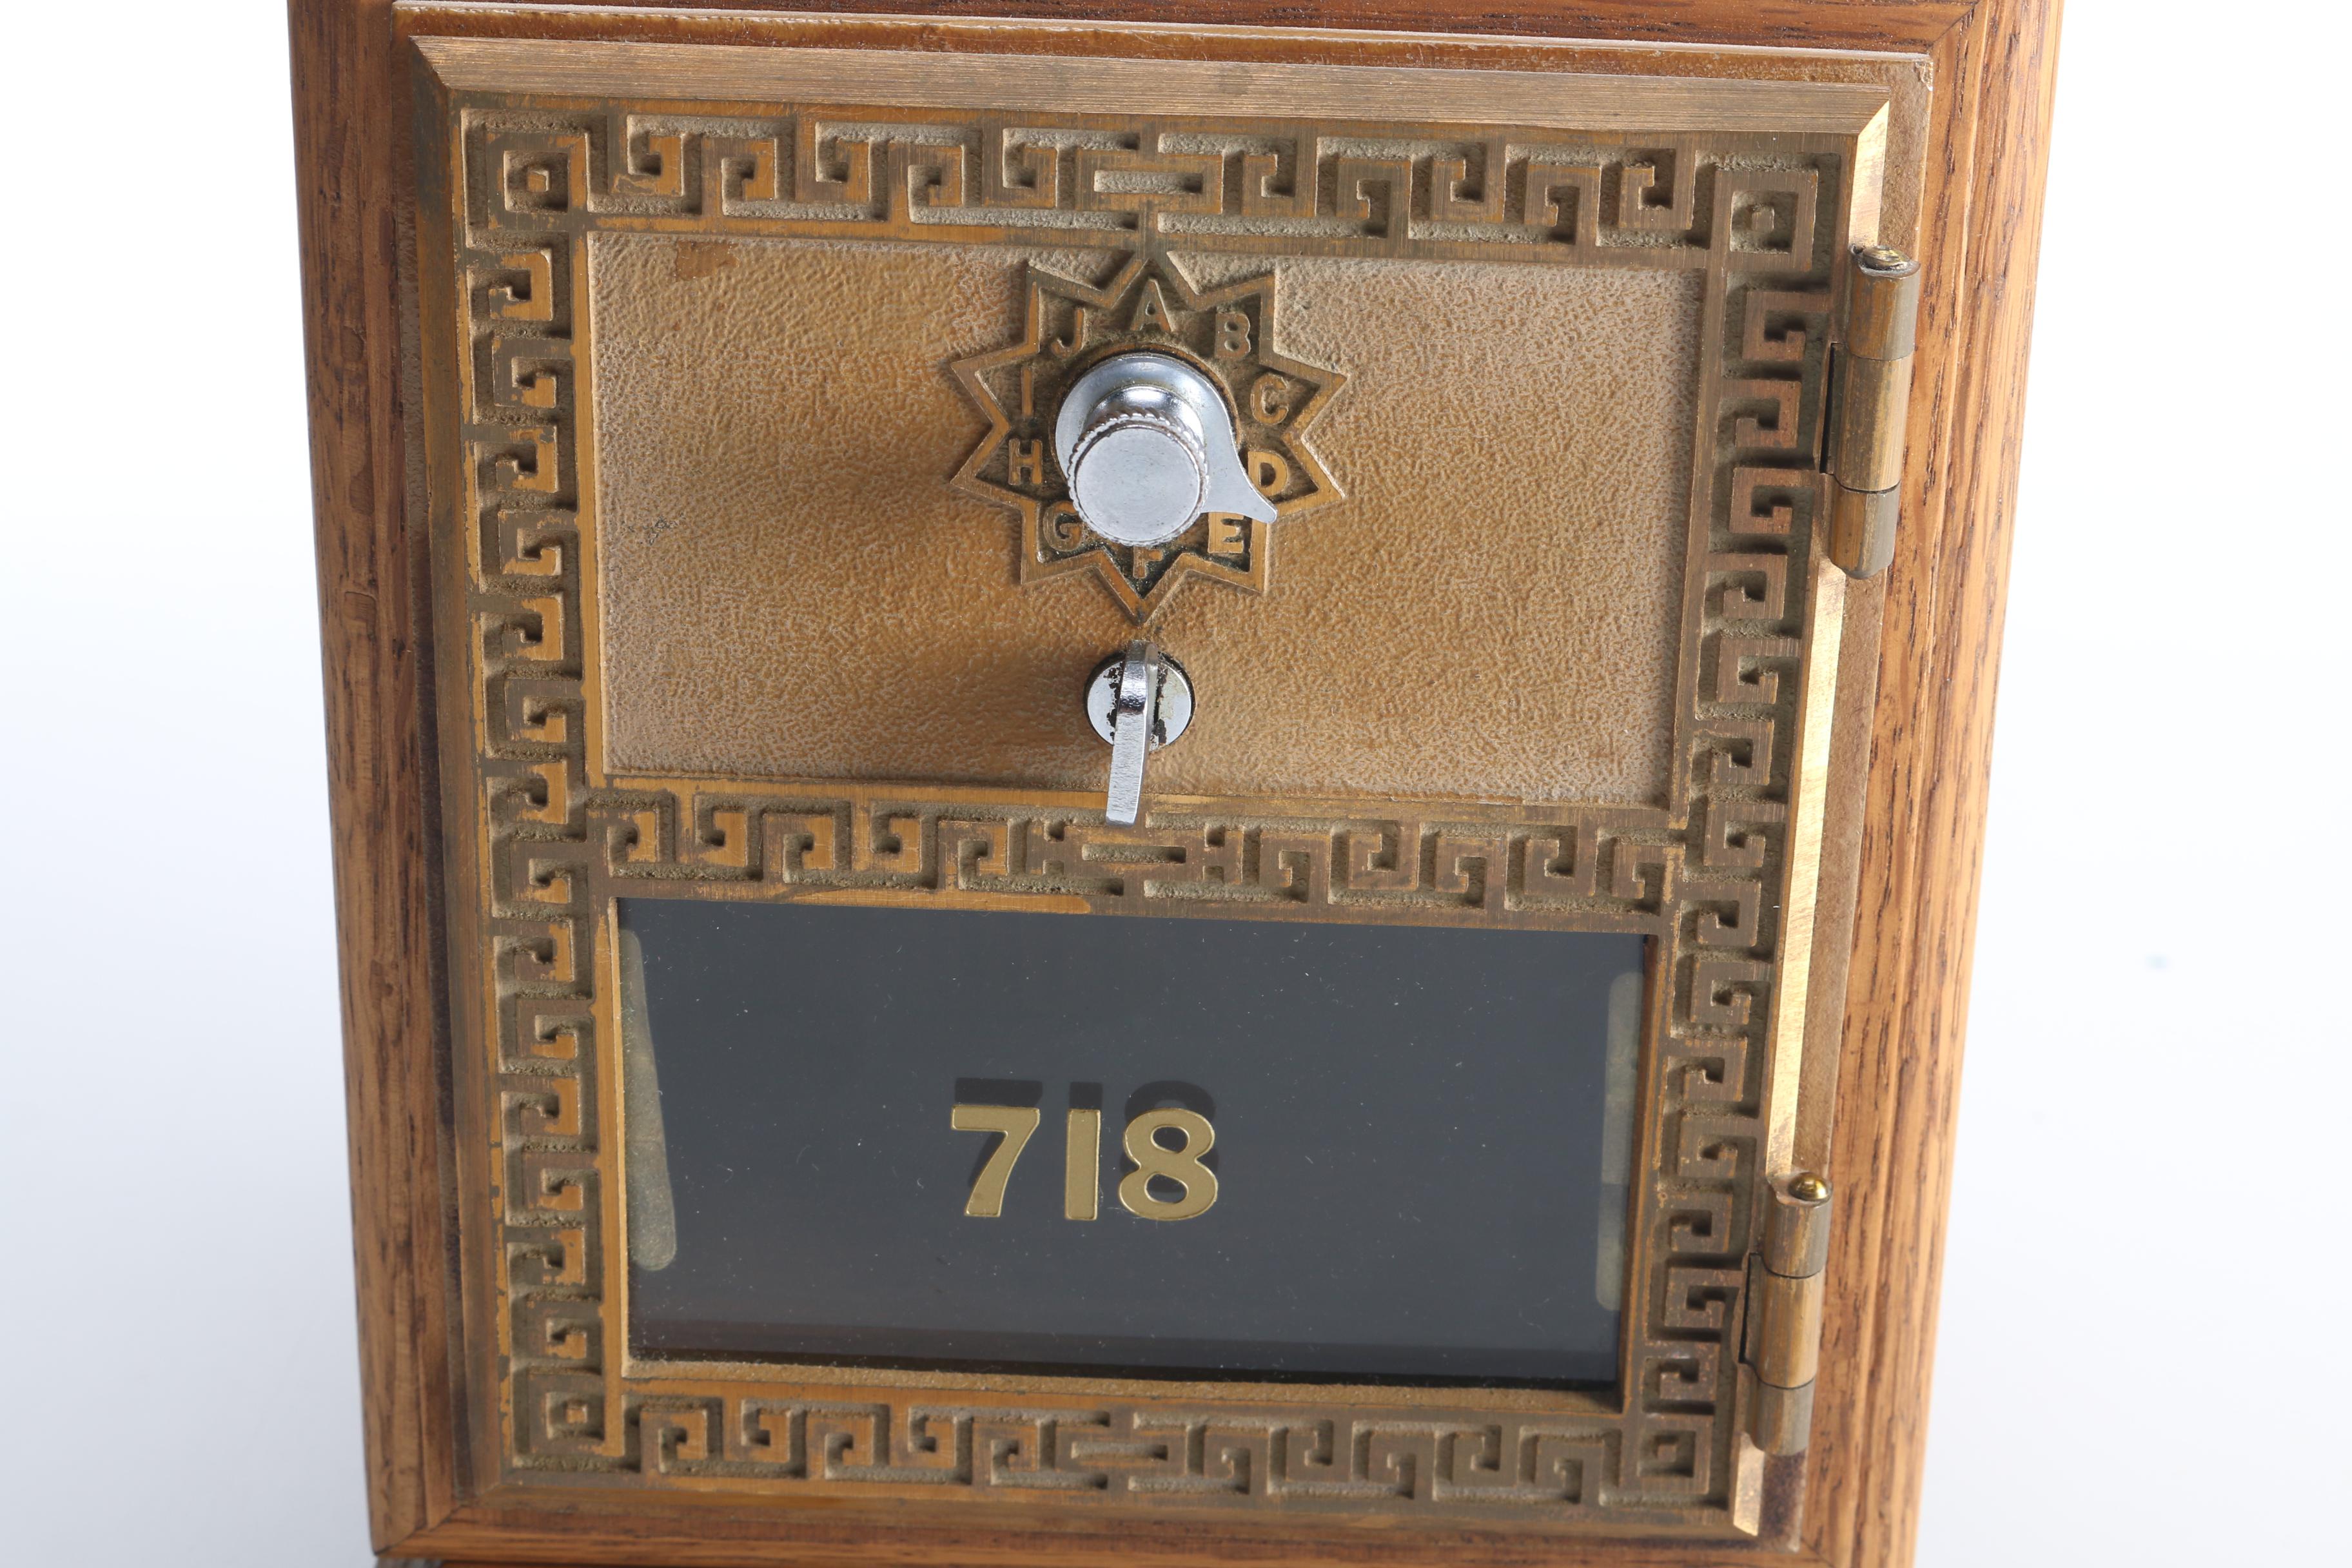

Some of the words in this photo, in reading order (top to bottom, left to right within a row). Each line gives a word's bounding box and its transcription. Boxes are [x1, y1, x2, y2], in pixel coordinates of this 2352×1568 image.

[1133, 279, 1172, 332] A
[1051, 307, 1084, 358] J
[1215, 311, 1251, 359] B
[1251, 374, 1289, 426] C
[1008, 438, 1043, 485] H
[1247, 451, 1289, 496] D
[1043, 501, 1084, 552] G
[1208, 512, 1245, 554] E
[950, 1104, 1219, 1221] 718
